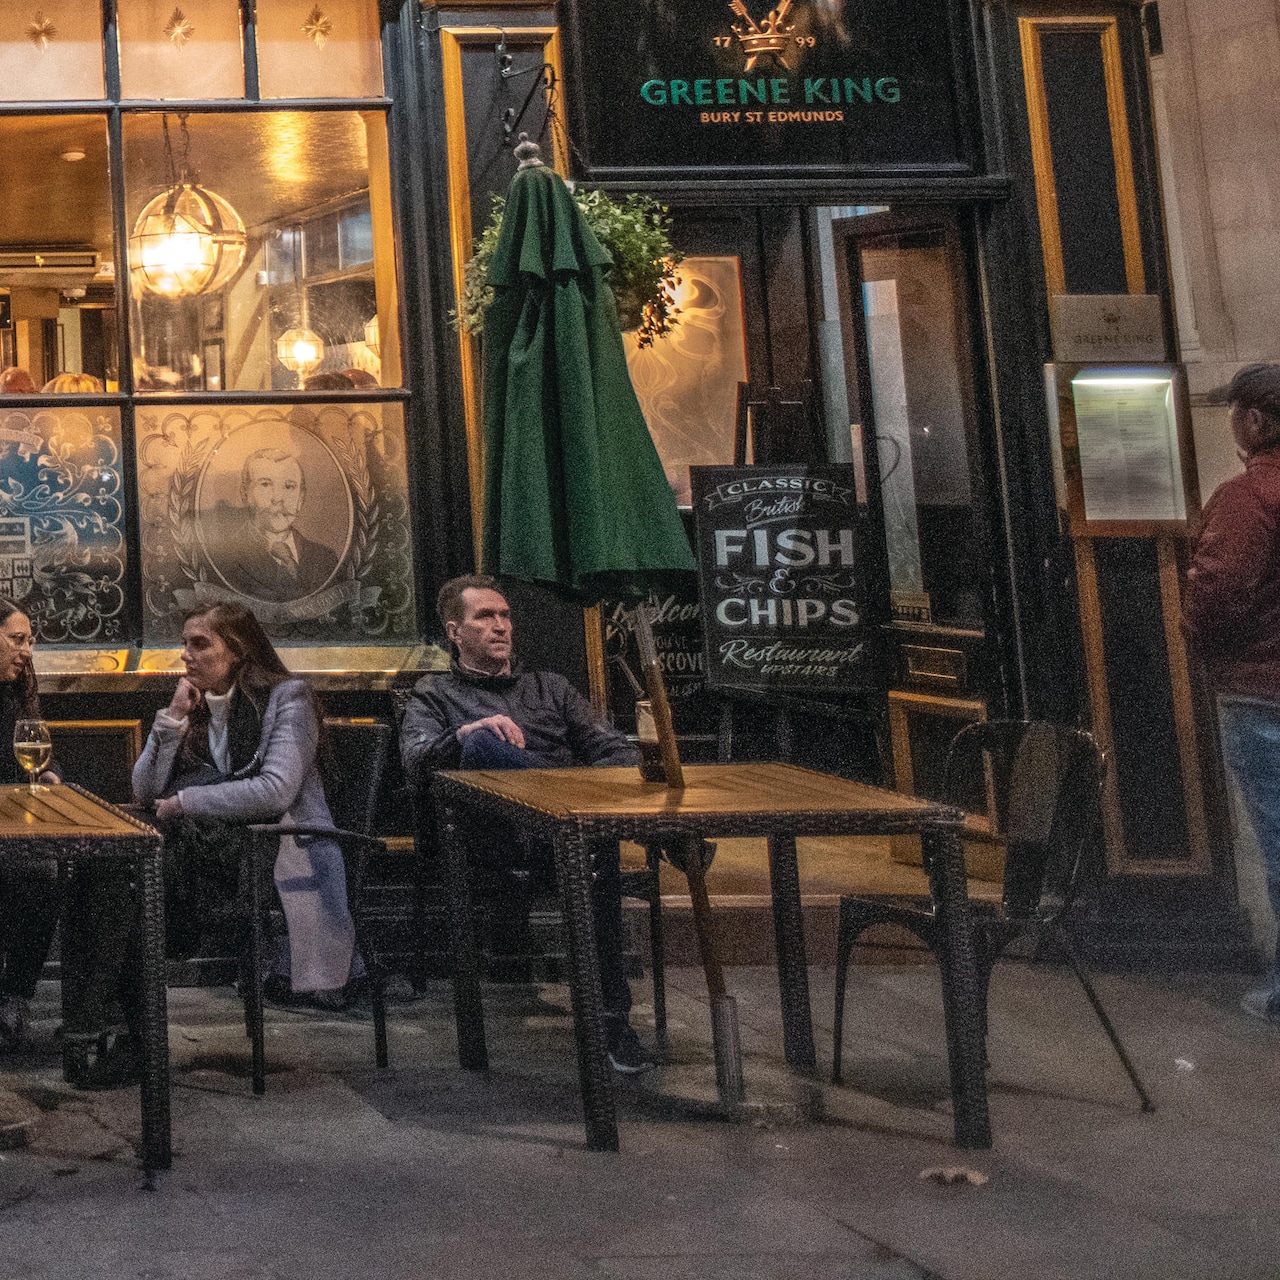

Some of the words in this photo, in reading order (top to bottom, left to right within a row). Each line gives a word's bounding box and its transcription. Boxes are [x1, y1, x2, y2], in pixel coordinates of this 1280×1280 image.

[712, 36, 731, 48] 17
[795, 36, 816, 48] 99
[640, 78, 790, 105] GREENE
[803, 77, 901, 104] KING
[700, 112, 740, 123] BURY
[745, 111, 762, 123] ST
[768, 111, 844, 122] EDMUNDS
[727, 478, 827, 495] CLASSIC
[744, 495, 807, 522] British
[714, 529, 855, 567] FISH
[769, 568, 796, 594] &
[715, 597, 860, 626] CHIPS
[719, 639, 864, 668] Restaurant
